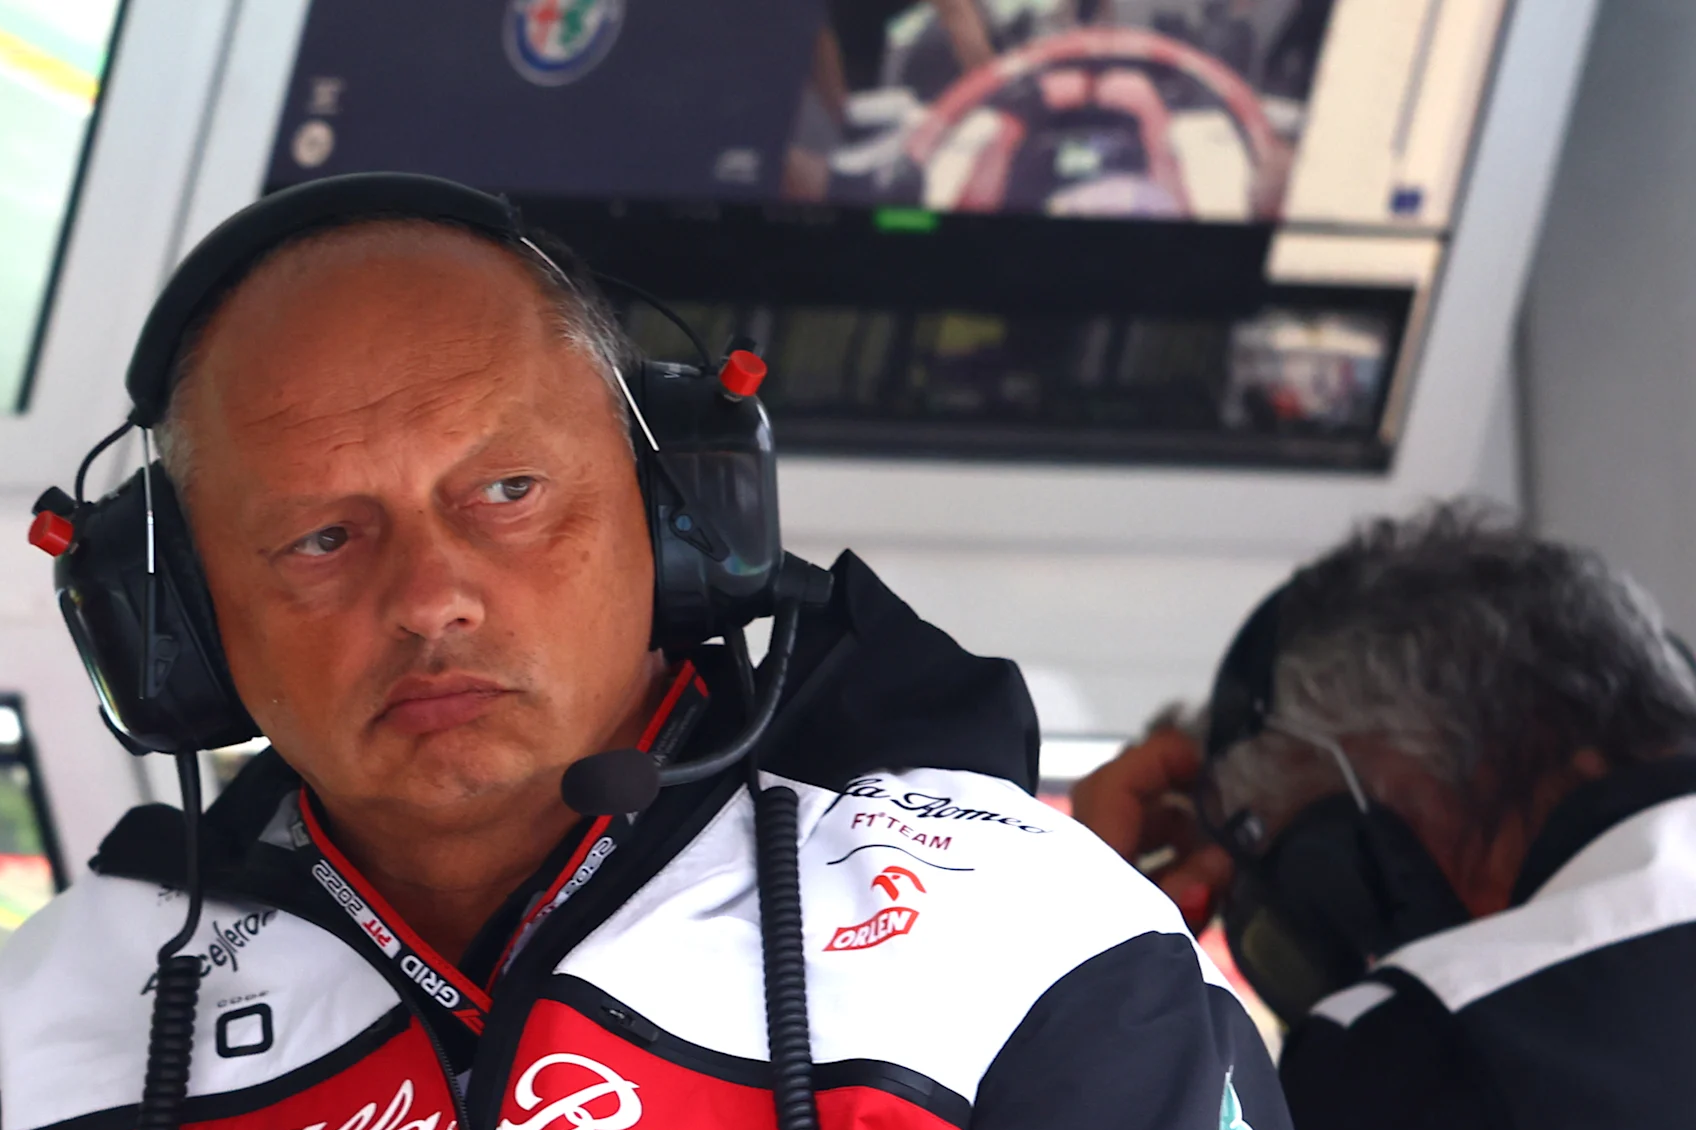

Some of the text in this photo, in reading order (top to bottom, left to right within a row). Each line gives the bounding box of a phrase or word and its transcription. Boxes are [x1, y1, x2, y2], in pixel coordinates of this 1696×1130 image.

[888, 817, 952, 850] TEAM
[889, 793, 1054, 834] Romeo
[312, 859, 460, 1009] GRID PIT 2022
[831, 910, 912, 949] ORLEN
